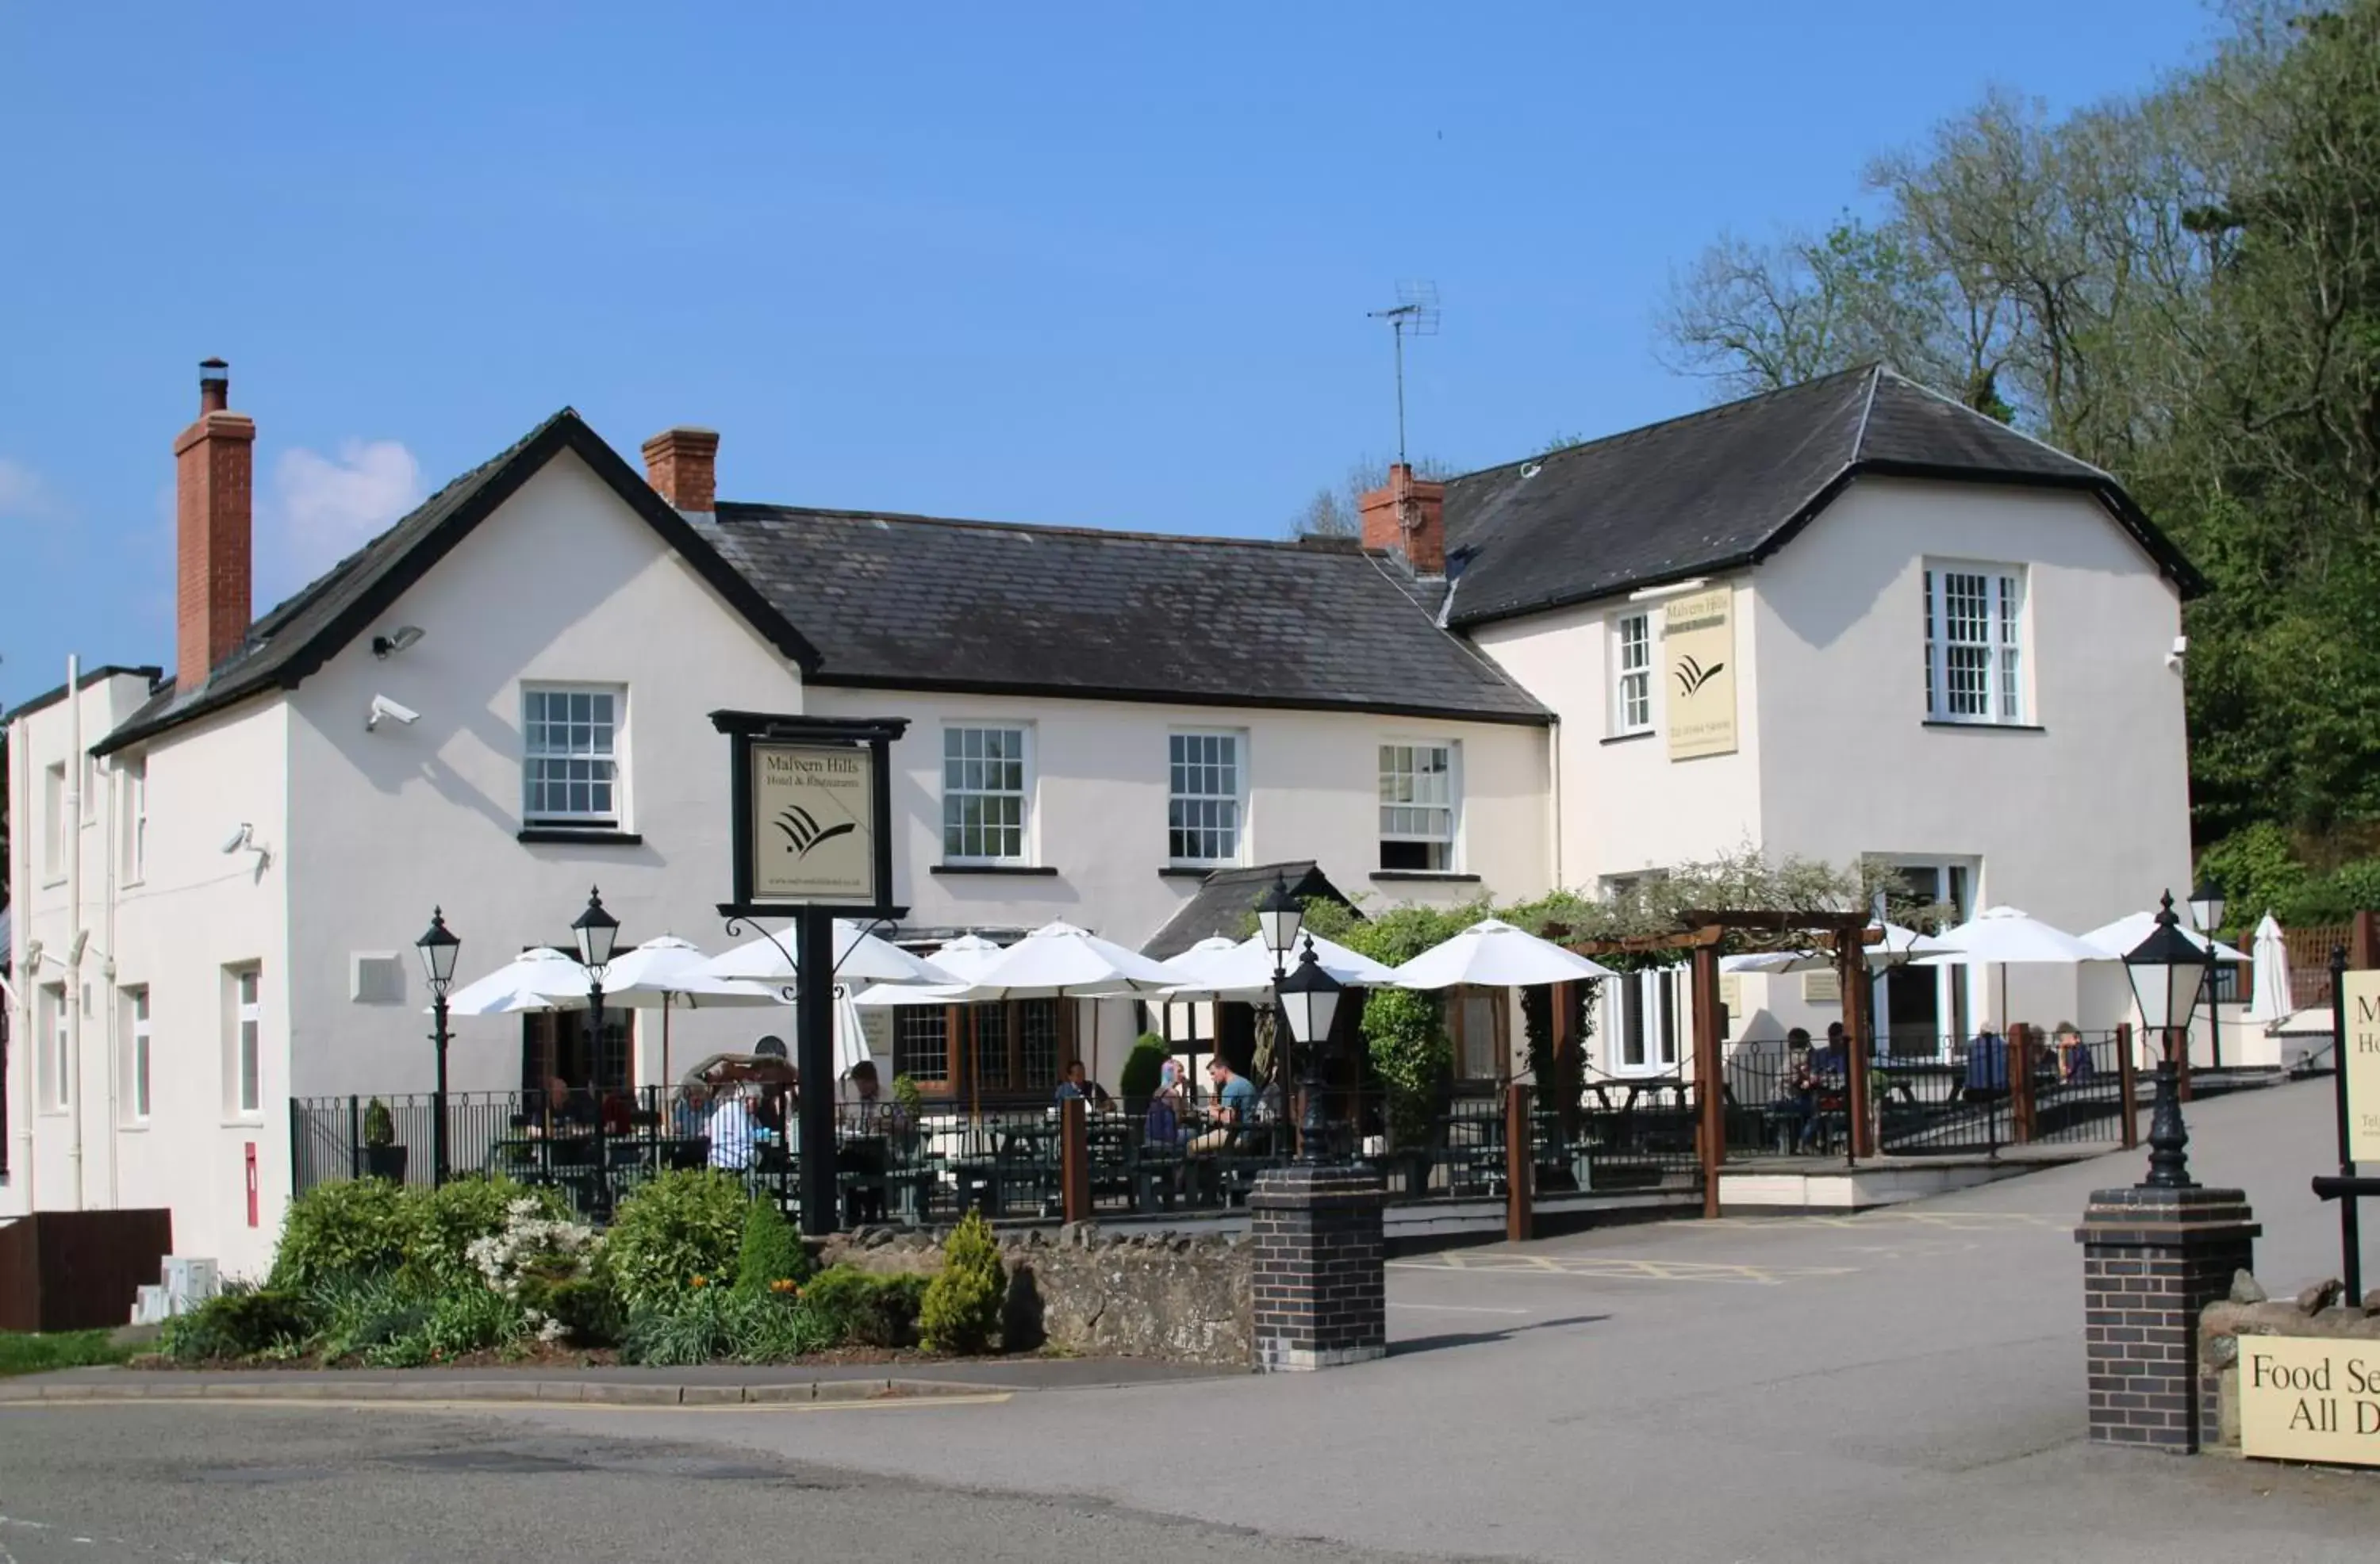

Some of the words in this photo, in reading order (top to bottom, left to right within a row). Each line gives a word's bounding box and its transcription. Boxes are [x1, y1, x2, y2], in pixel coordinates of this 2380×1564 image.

[766, 755, 823, 772] Malvern
[827, 758, 859, 774] Hills
[766, 774, 793, 787] Hotel
[2252, 1354, 2332, 1392] Food
[2288, 1396, 2339, 1433] All
